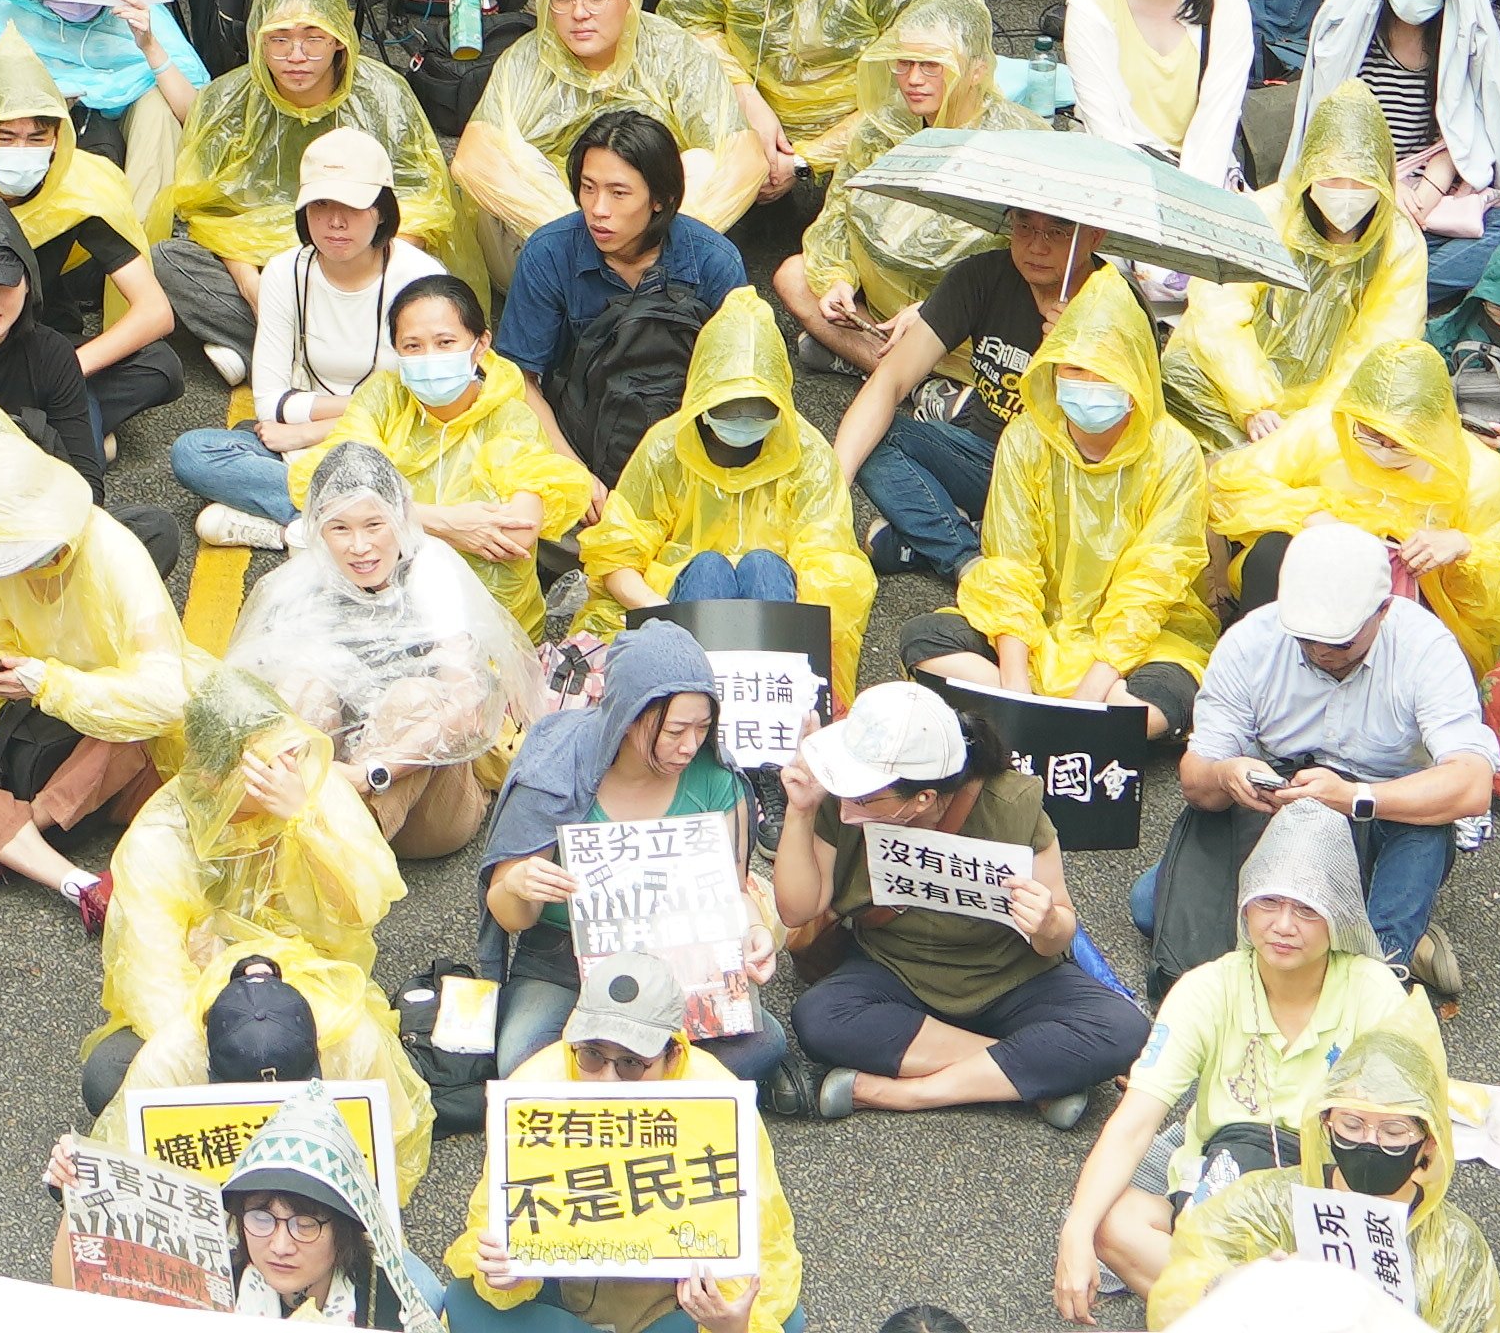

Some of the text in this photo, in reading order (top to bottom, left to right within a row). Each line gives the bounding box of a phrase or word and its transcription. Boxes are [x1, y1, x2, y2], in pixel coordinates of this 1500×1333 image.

[568, 819, 722, 863] 惡劣立委
[880, 839, 1017, 893] 沒有討論
[518, 1109, 677, 1148] 沒有討論
[71, 1152, 222, 1225] 有害立委
[501, 1146, 745, 1235] 不是民主
